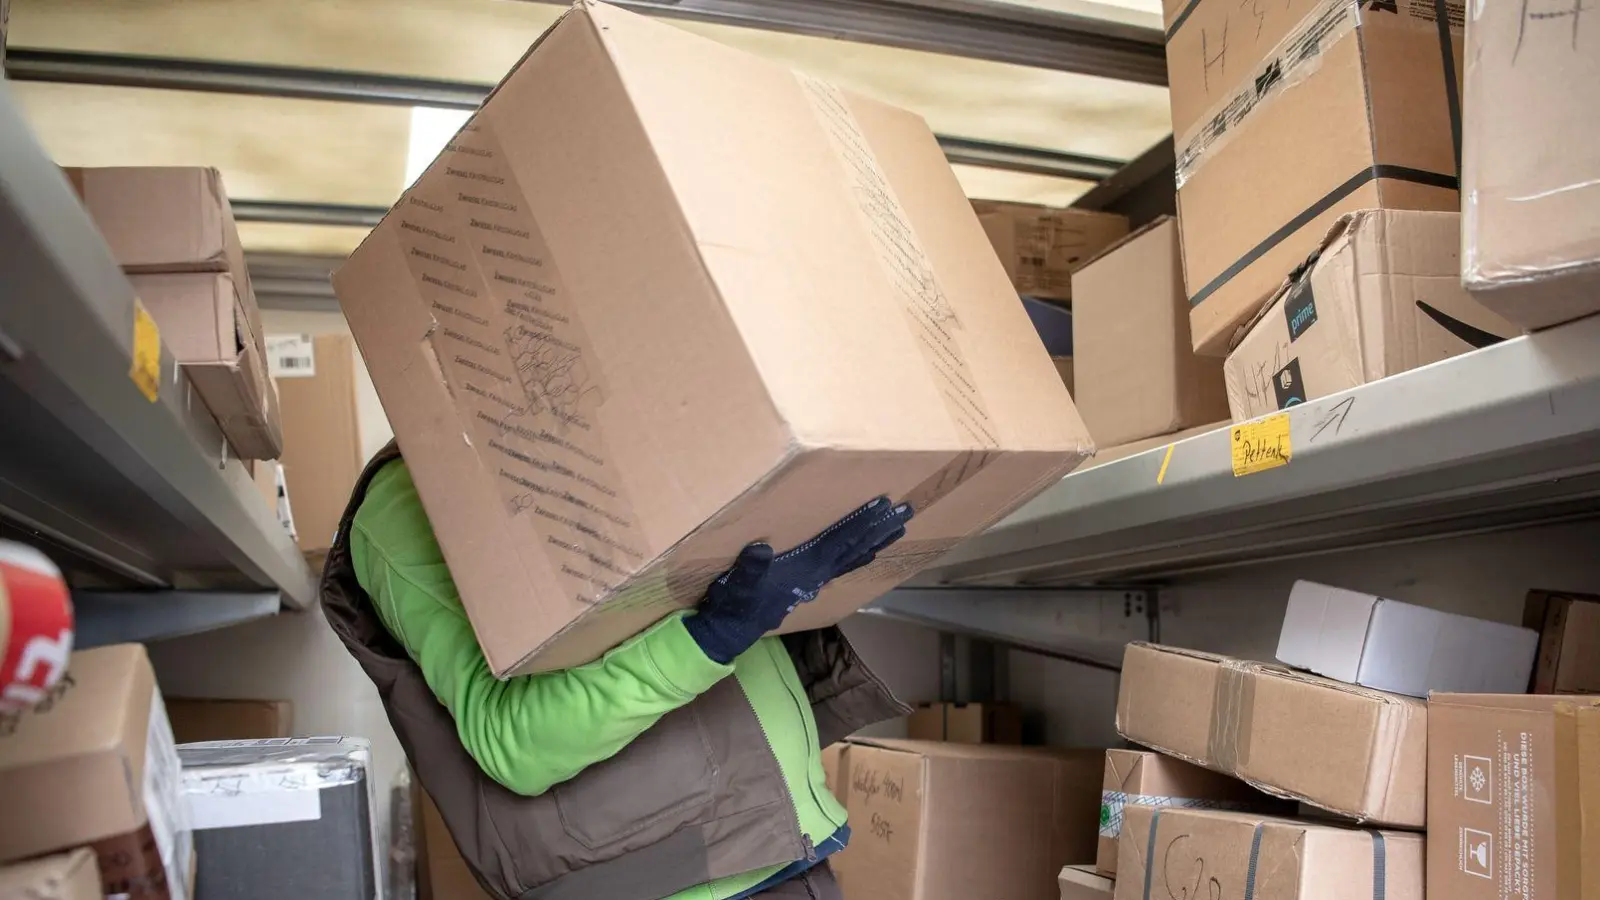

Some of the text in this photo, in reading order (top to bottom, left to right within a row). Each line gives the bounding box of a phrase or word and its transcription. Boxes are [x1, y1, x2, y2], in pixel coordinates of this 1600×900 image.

[1291, 302, 1315, 336] prime
[1520, 732, 1528, 765] DIESE
[1520, 767, 1528, 792] BOX
[1521, 793, 1529, 836] WURDE
[1521, 839, 1529, 860] MIT
